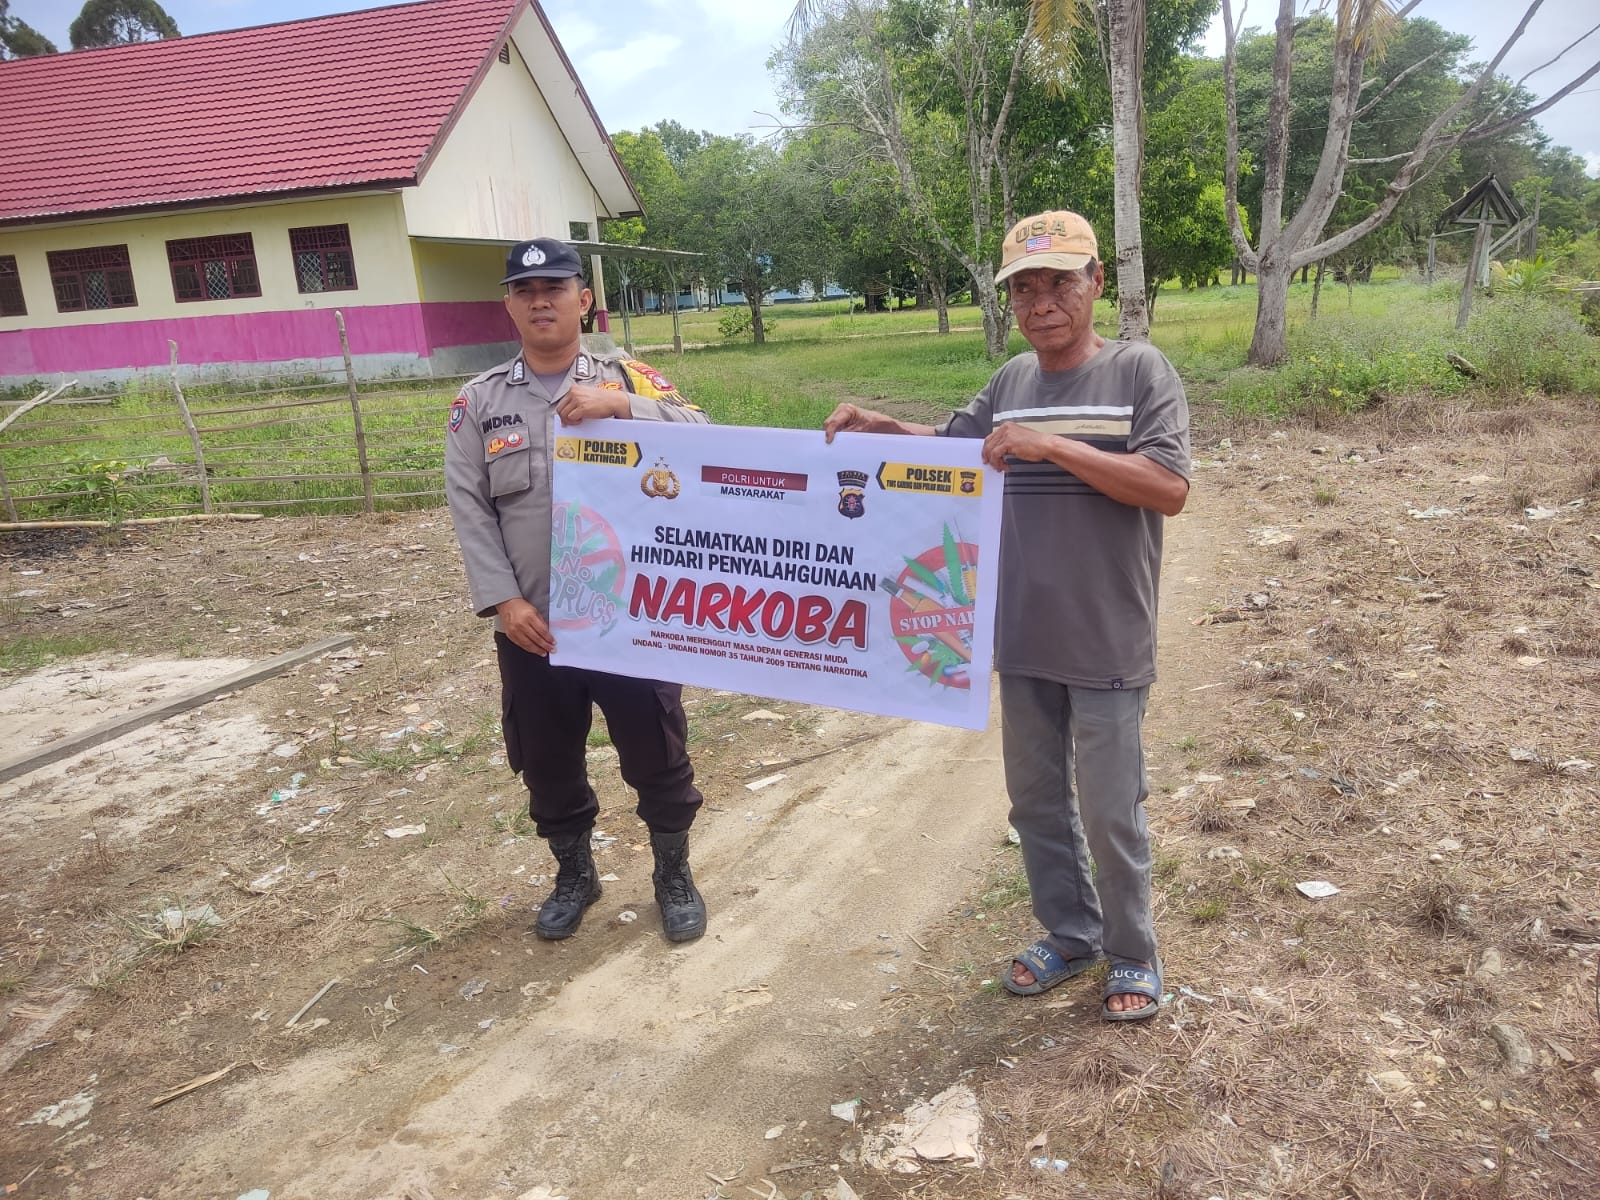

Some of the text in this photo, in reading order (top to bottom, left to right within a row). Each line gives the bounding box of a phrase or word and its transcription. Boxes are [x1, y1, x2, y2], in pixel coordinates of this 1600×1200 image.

[1016, 220, 1066, 243] USA
[583, 453, 627, 465] KATINGAN
[584, 440, 627, 455] POLRES
[721, 473, 785, 487] POLRI UNTUK
[906, 468, 952, 483] POLSEK
[720, 486, 785, 500] MASYARAKAT
[654, 525, 854, 566] SELAMATKAN DIRI DAN
[560, 551, 592, 581] NO
[631, 545, 876, 592] HINDARI PENYALAHGUNAAN
[628, 572, 868, 650] NARKOBA
[899, 614, 942, 632] STOP
[632, 638, 662, 649] UNDANG
[668, 643, 698, 654] UNDANG
[700, 647, 727, 658] NOMOR
[728, 651, 738, 660] 35
[740, 653, 764, 663] TAHUN
[765, 657, 785, 667] 2009
[787, 660, 821, 672] TENTANG
[823, 665, 868, 679] NARKOTIKA
[650, 630, 848, 664] NARKOBA MERENGGUT MASA DEPAN GENERASI MUDA
